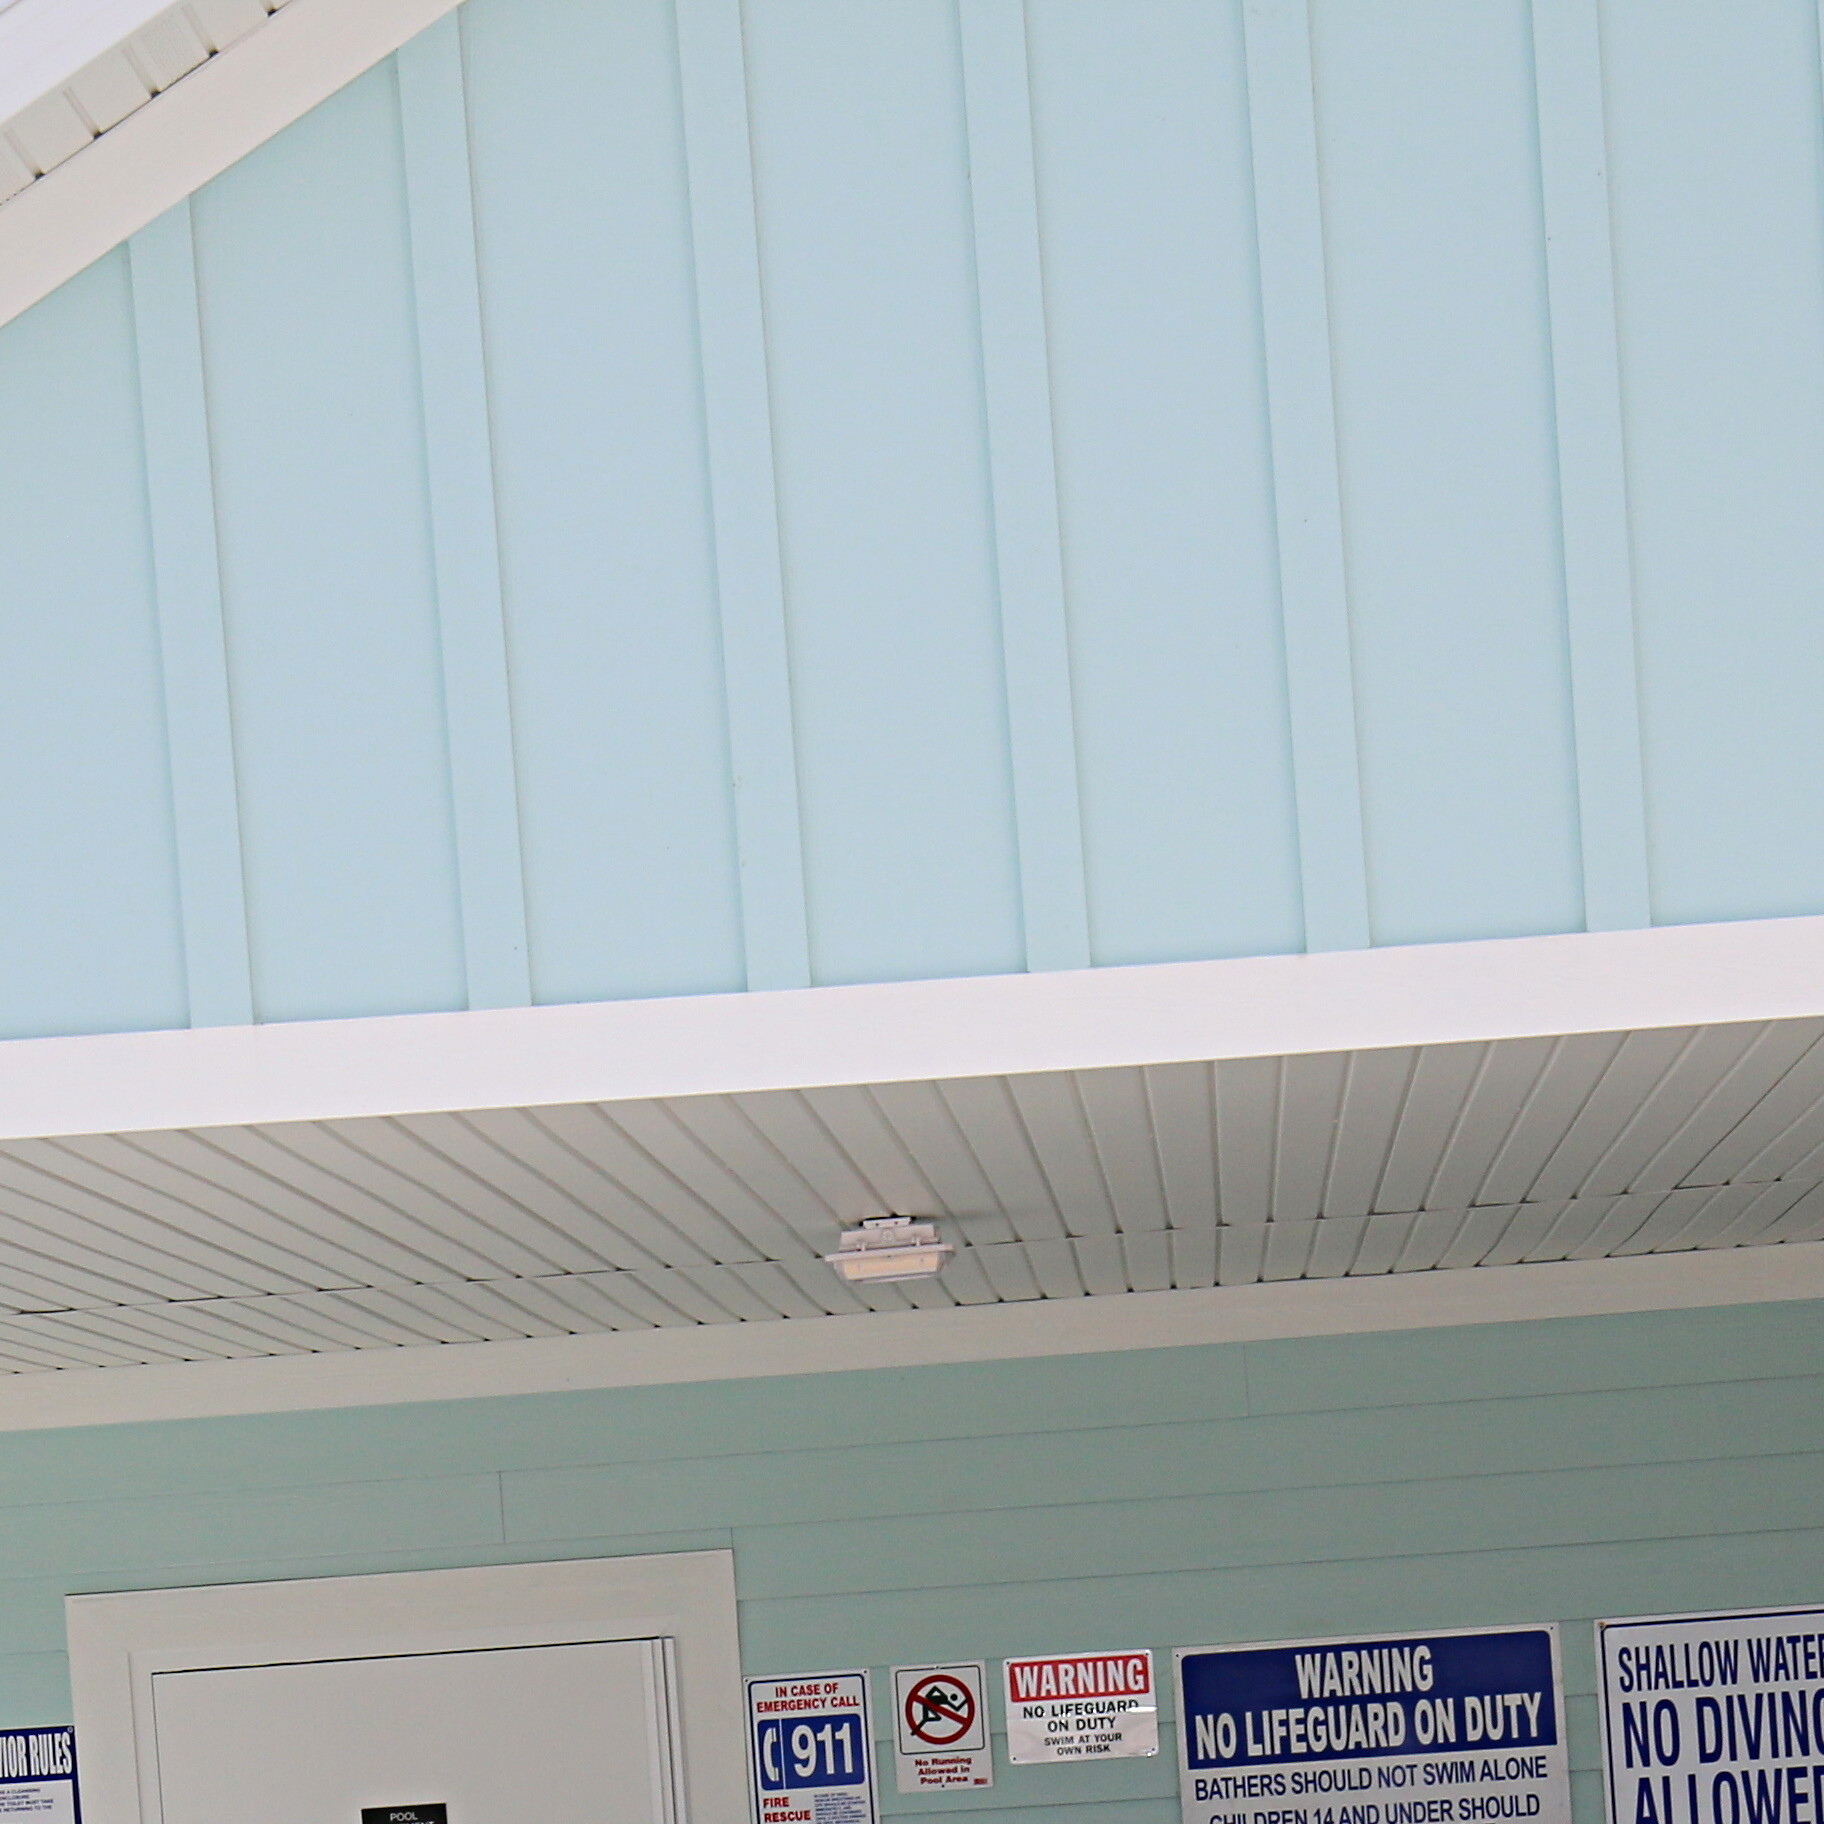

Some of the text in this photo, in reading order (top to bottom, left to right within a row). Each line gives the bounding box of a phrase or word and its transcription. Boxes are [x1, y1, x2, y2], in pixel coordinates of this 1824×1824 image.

[1294, 1644, 1434, 1700] WARNING
[1617, 1638, 1741, 1693] SHALLOW
[1014, 1657, 1144, 1698] WARNING
[775, 1682, 838, 1698] IN CASE OF
[756, 1694, 860, 1713] EMERGENCY CALL
[1022, 1698, 1139, 1719] NO LIFEGUARD
[1047, 1715, 1116, 1733] ON DUTY
[1194, 1691, 1544, 1760] NO LIFEGUARD ON DUTY
[1621, 1698, 1681, 1769] NO
[1044, 1731, 1122, 1746] SWIM AT YOUR
[28, 1731, 72, 1776] RULES
[790, 1721, 853, 1777] 911
[1056, 1743, 1110, 1755] OWN RISK
[914, 1755, 972, 1769] No Running
[917, 1765, 970, 1776] Allowed in
[919, 1775, 942, 1785] Pool
[945, 1774, 968, 1783] Area
[1194, 1754, 1548, 1801] BATHERS SHOULD NOT SWIM ALONE
[762, 1796, 789, 1809] FIRE
[1384, 1798, 1454, 1824] UNDER
[1458, 1792, 1540, 1821] SHOULD
[389, 1811, 419, 1822] POOL
[763, 1809, 811, 1823] RESCUE
